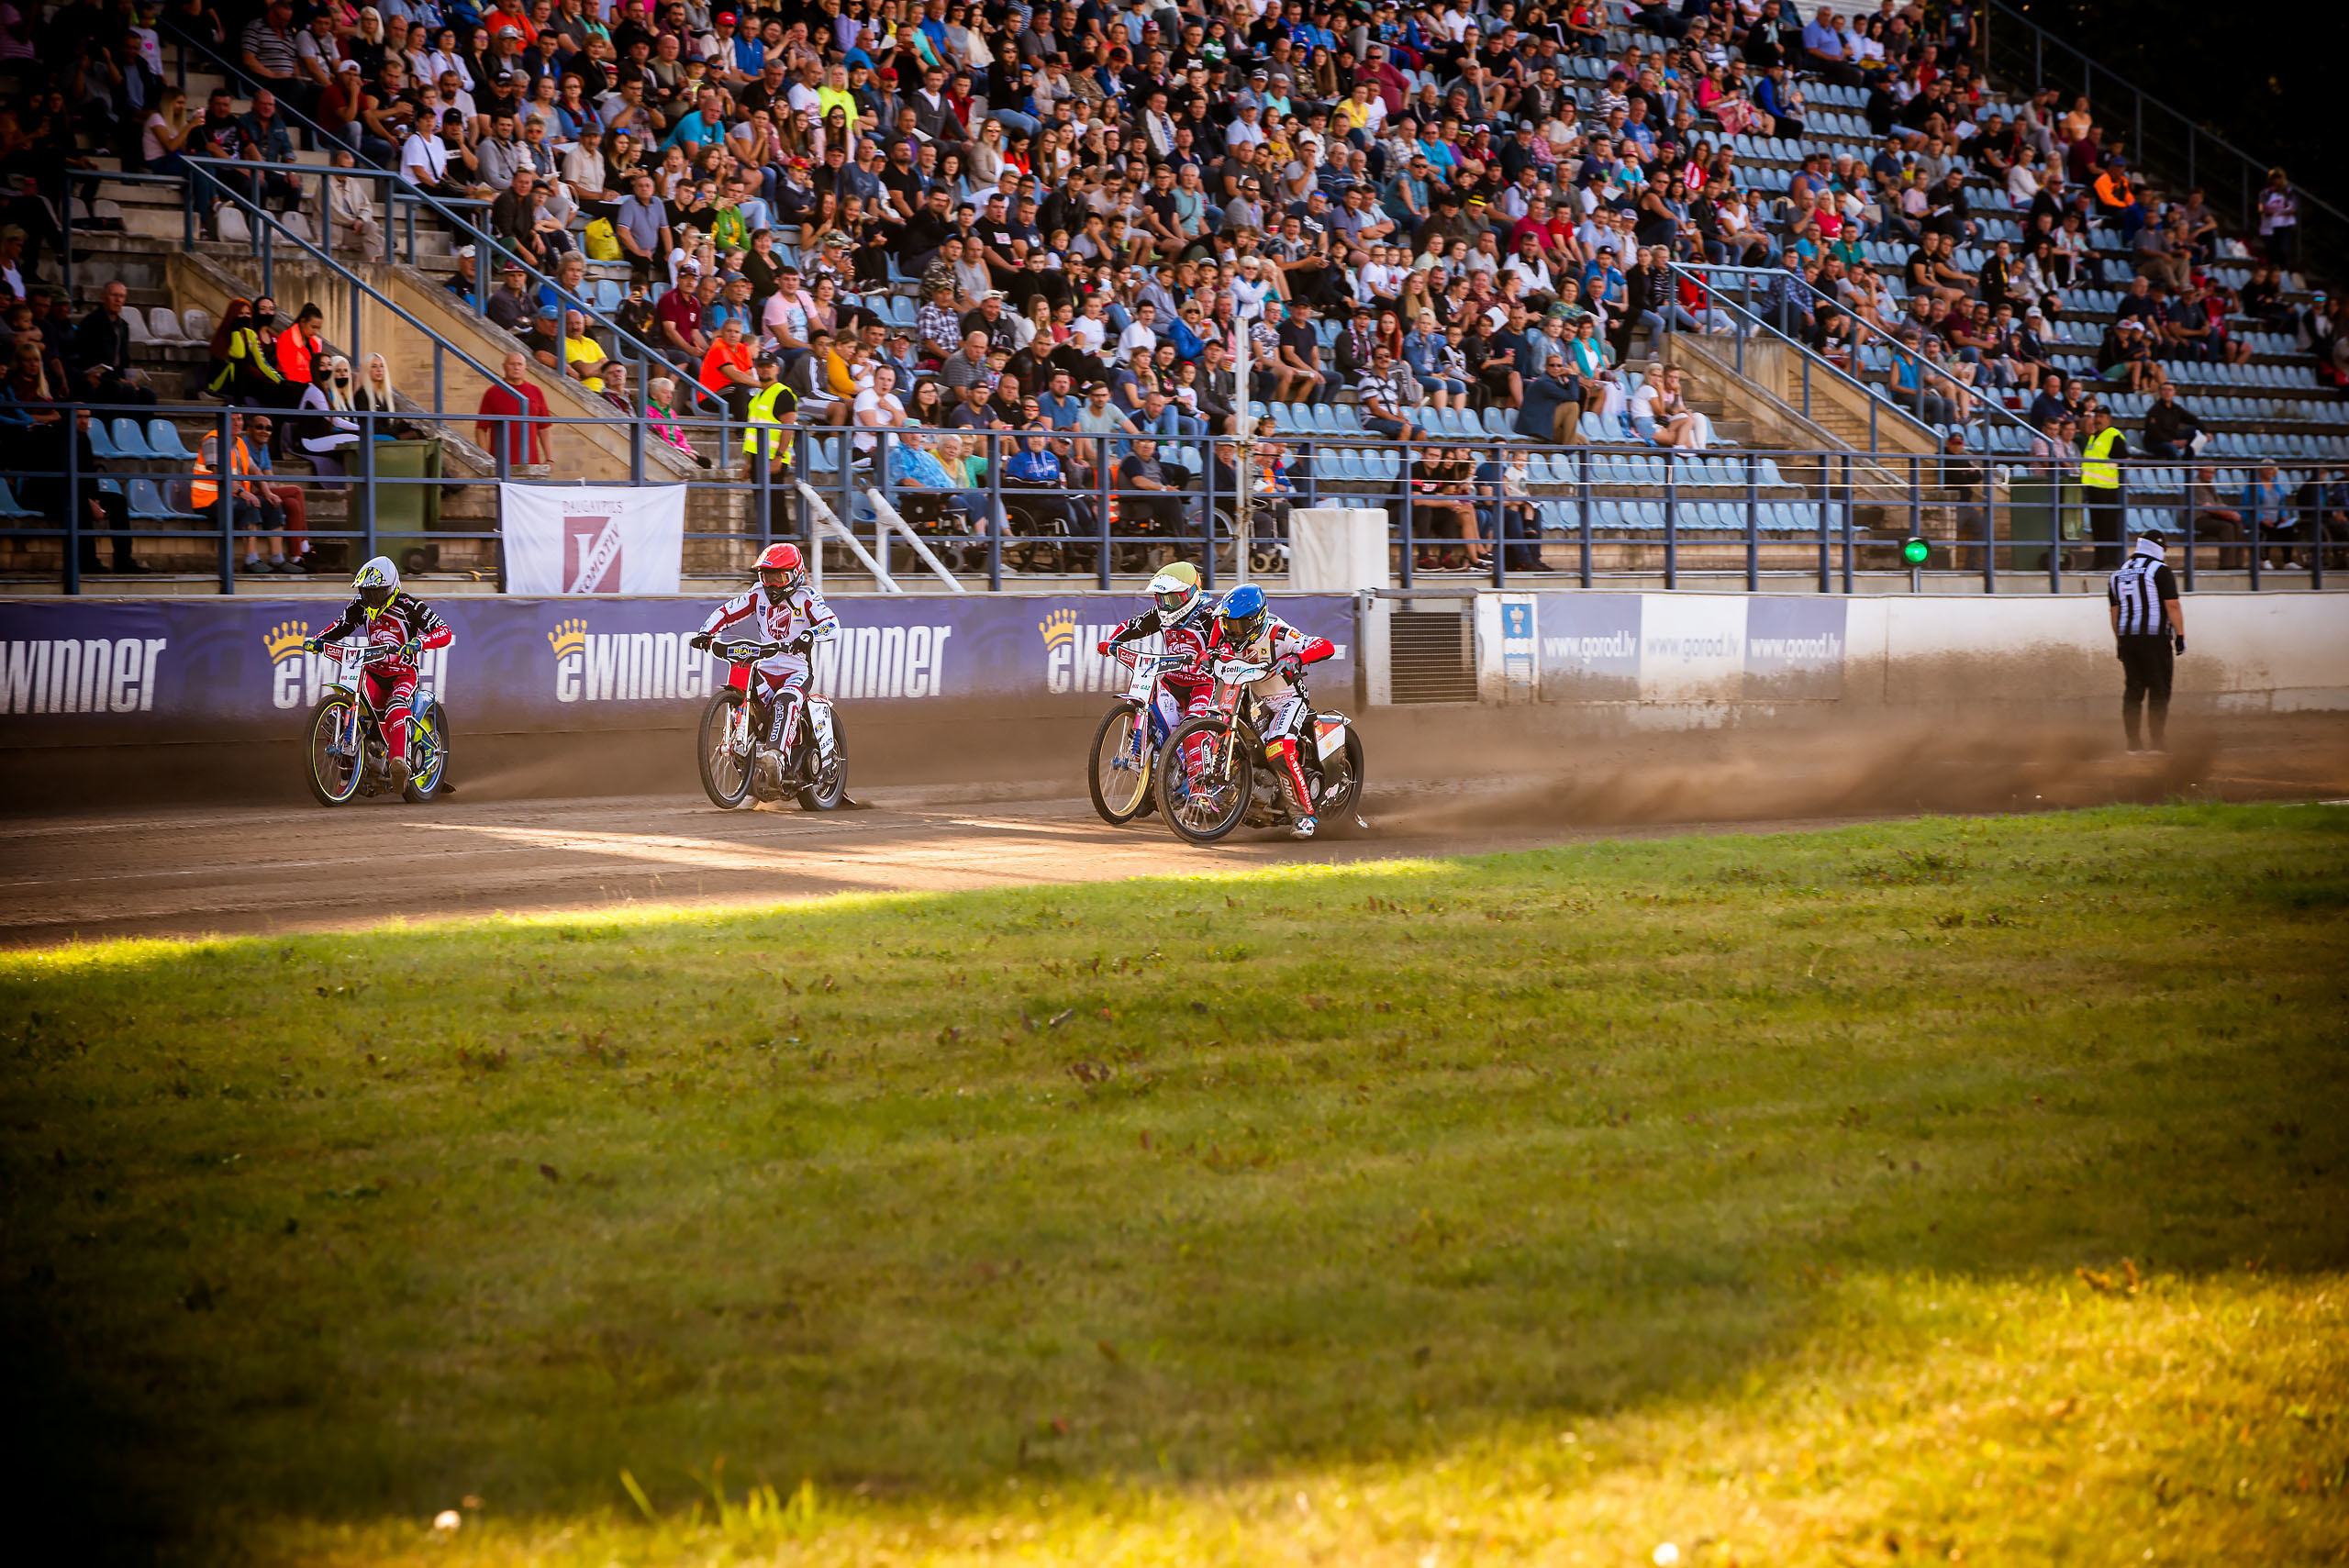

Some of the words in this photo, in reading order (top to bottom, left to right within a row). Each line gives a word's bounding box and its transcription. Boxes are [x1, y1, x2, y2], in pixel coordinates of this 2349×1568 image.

[1543, 630, 1636, 664] www.gorod.lv
[1647, 632, 1741, 663] www.gorod.lv
[1751, 632, 1842, 664] www.gorod.lv
